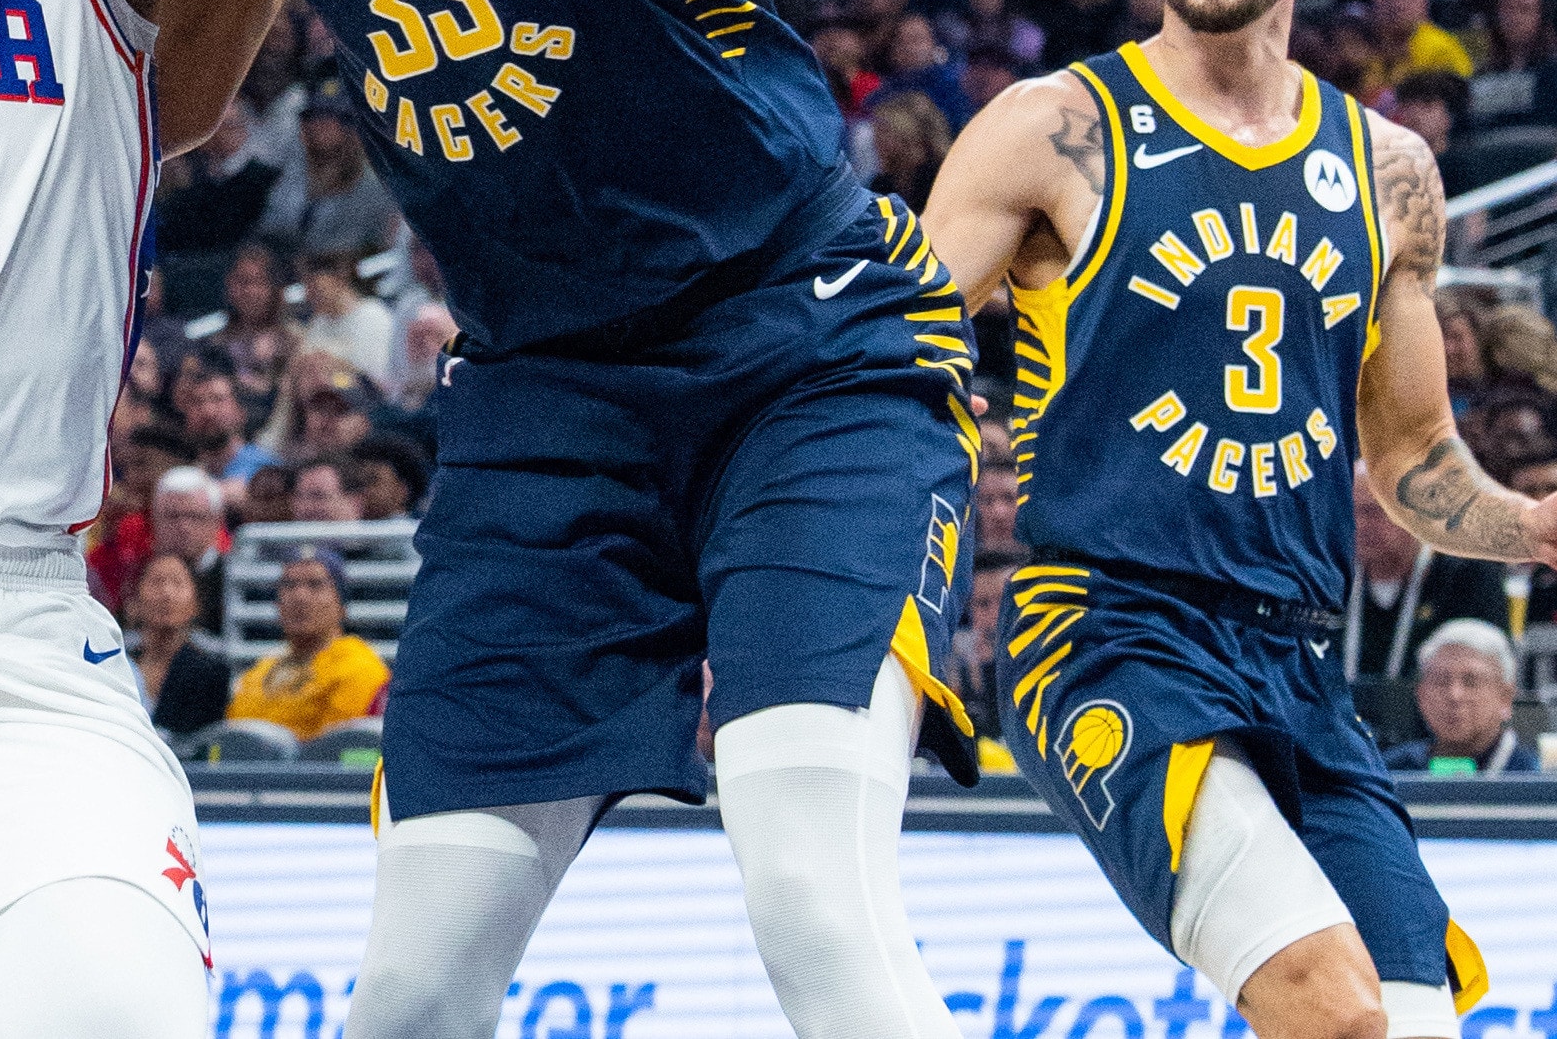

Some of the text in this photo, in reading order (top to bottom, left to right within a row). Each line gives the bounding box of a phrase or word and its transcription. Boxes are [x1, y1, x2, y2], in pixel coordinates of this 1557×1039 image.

[364, 22, 576, 162] PACERS
[1129, 104, 1156, 134] 6
[1128, 202, 1361, 330] INDIANA
[1224, 286, 1285, 415] 3
[1129, 390, 1337, 499] PACERS
